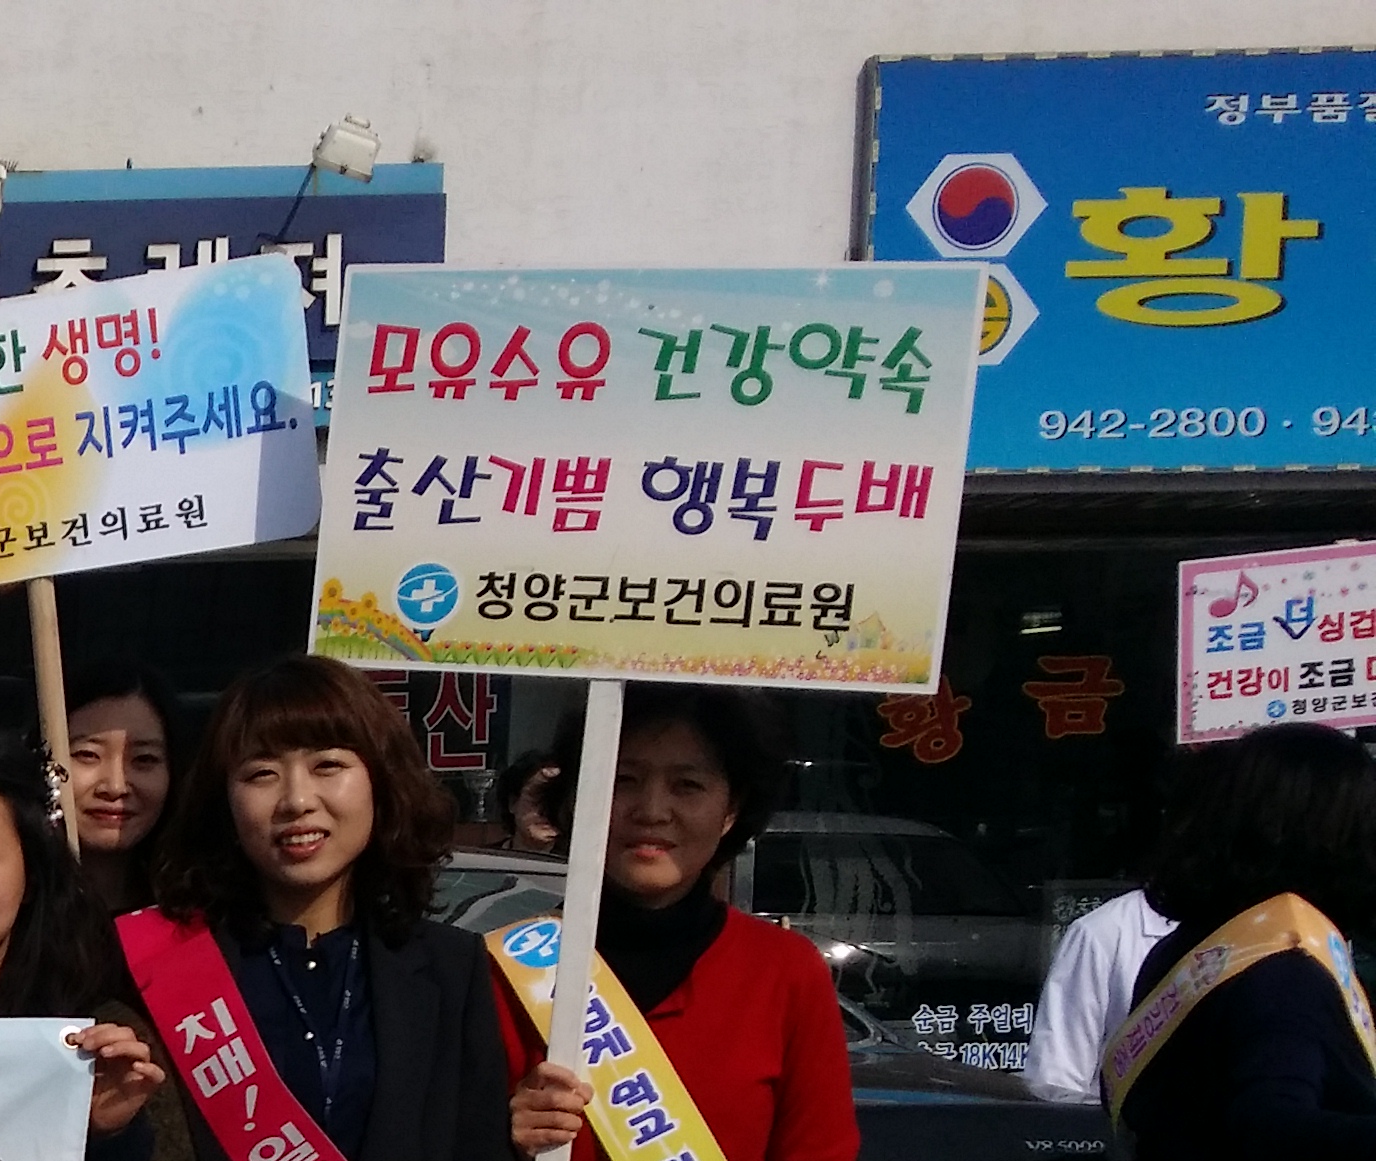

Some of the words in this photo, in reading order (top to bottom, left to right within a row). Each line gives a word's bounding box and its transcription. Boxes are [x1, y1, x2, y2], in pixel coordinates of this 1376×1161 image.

[1064, 187, 1323, 328] 황
[42, 307, 161, 386] 생명!
[367, 320, 612, 402] 모유수유
[638, 322, 934, 414] 건강약속
[74, 379, 298, 459] 지켜주세요.
[1039, 406, 1267, 440] 942-2800
[1313, 405, 1376, 438] 94
[351, 446, 612, 533] 출산기쁨
[640, 454, 935, 542] 행복두배
[474, 571, 856, 633] 청양군보건의료원
[1206, 621, 1267, 653] 조금
[1284, 596, 1315, 625] 더
[1206, 665, 1289, 700] 건강이
[1298, 657, 1356, 690] 조금
[911, 1003, 959, 1034] 순금
[966, 1003, 1034, 1035] 주얼리
[174, 996, 260, 1132] 치매!
